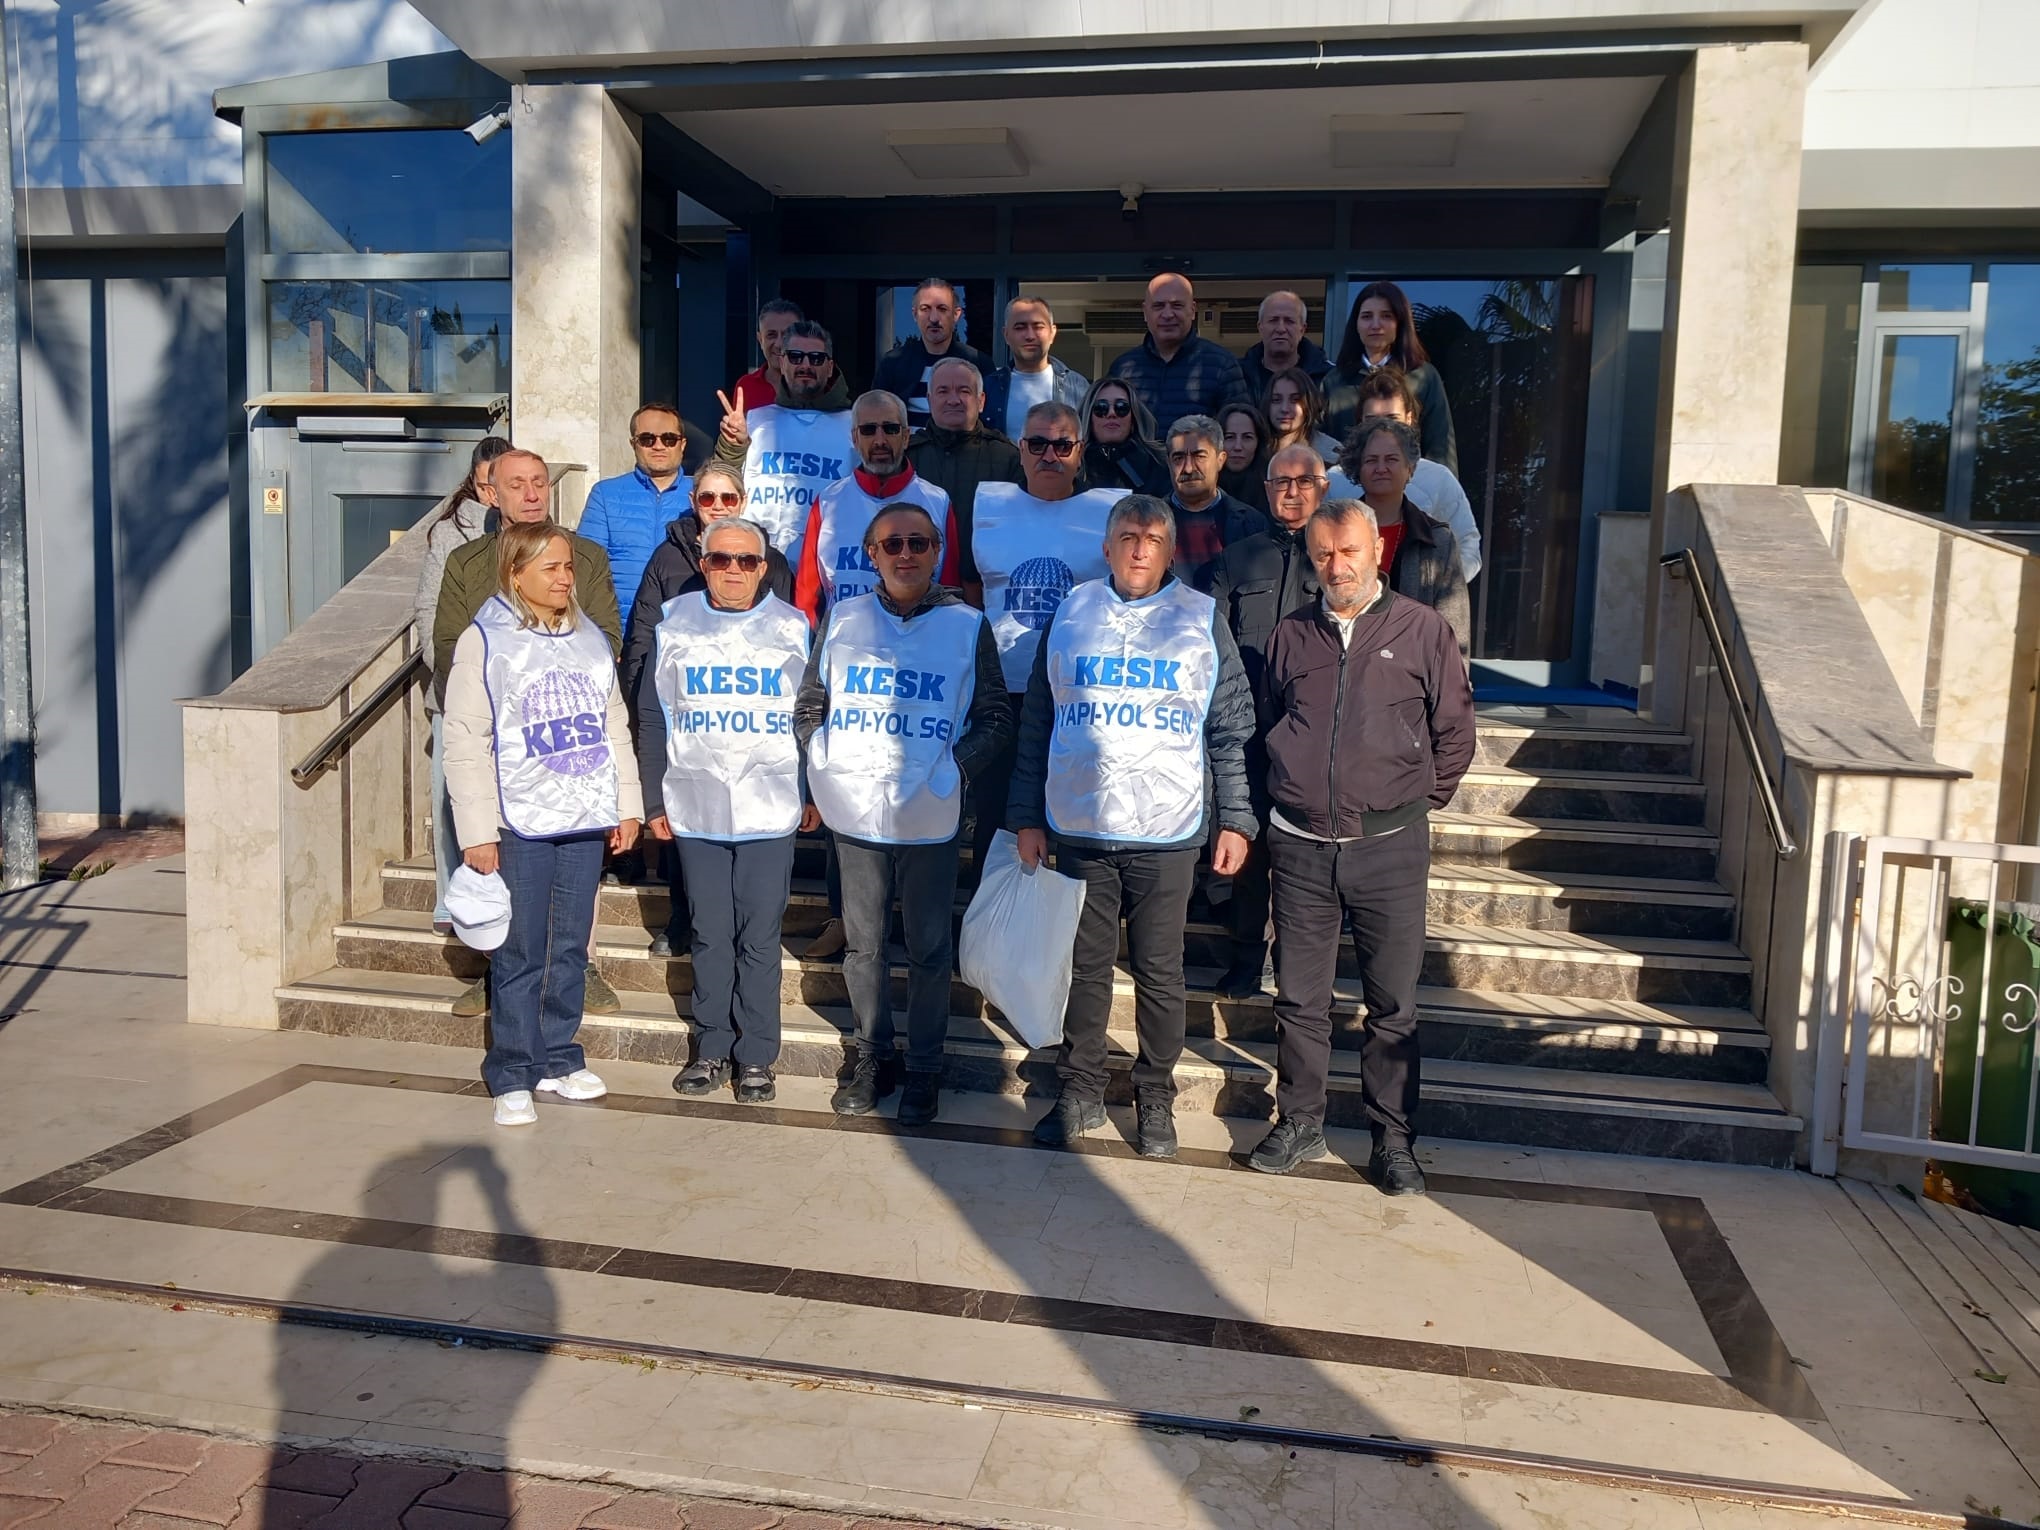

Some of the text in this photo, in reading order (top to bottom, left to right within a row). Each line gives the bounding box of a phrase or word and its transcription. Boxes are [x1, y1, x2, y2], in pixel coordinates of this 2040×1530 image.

[761, 451, 842, 481] KESK
[1003, 587, 1069, 612] KES
[686, 666, 782, 697] KESK
[844, 665, 946, 702] KESK
[1074, 656, 1181, 691] KESK
[829, 708, 914, 738] API-YOL
[1059, 701, 1194, 735] YAPI-YOL SEN
[521, 711, 607, 759] KES
